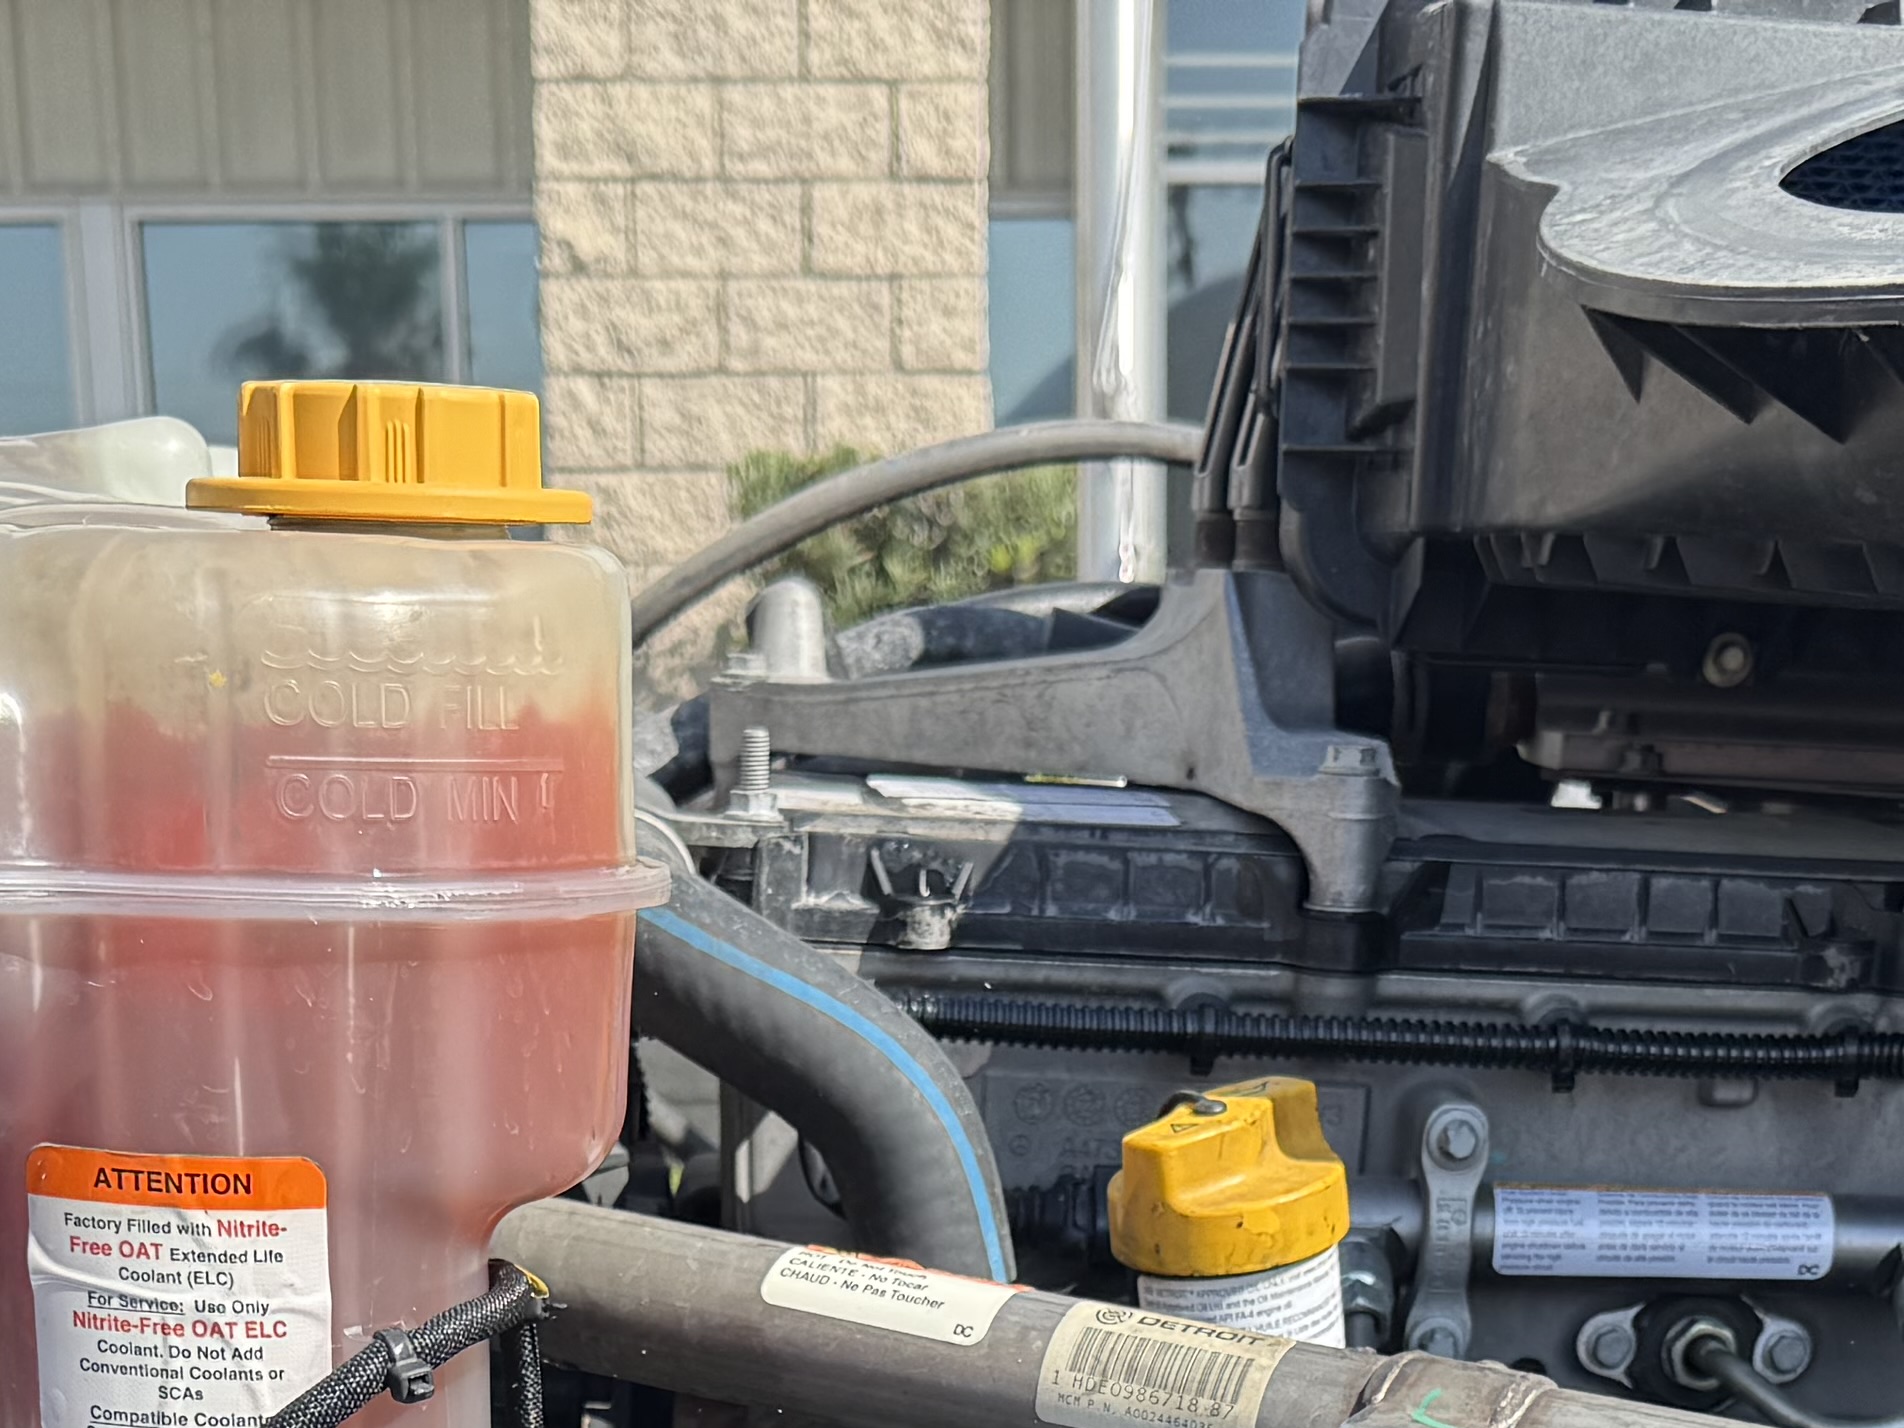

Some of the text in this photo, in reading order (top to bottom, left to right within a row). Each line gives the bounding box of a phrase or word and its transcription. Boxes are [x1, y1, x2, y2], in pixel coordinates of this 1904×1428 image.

[262, 678, 520, 732] COLD FILL
[274, 772, 520, 824] COLD MIN
[93, 1166, 253, 1195] ATTENTION
[63, 1212, 288, 1239] Factory Filled with Nitrite-
[69, 1236, 284, 1265] Free OAT Extended Life
[118, 1266, 235, 1290] Coolant (ELC)
[779, 1266, 831, 1286] CHAUD
[861, 1285, 888, 1299] Pas
[890, 1290, 946, 1310] Toucher
[788, 1257, 930, 1292] CALIENTE No Tocar
[87, 1291, 270, 1317] For Service: Use Only
[72, 1310, 288, 1339] Nitrite-Free OAT ELC
[952, 1322, 974, 1339] DC
[1136, 1315, 1265, 1346] DETROIT
[97, 1339, 264, 1361] Coolant. Do Not Add
[79, 1358, 286, 1382] Conventional Coolants or
[158, 1385, 204, 1401] SCAs
[1051, 1369, 1236, 1421] 1 HDE0986718 87
[1057, 1391, 1081, 1407] MCM
[90, 1406, 189, 1427] Compatible
